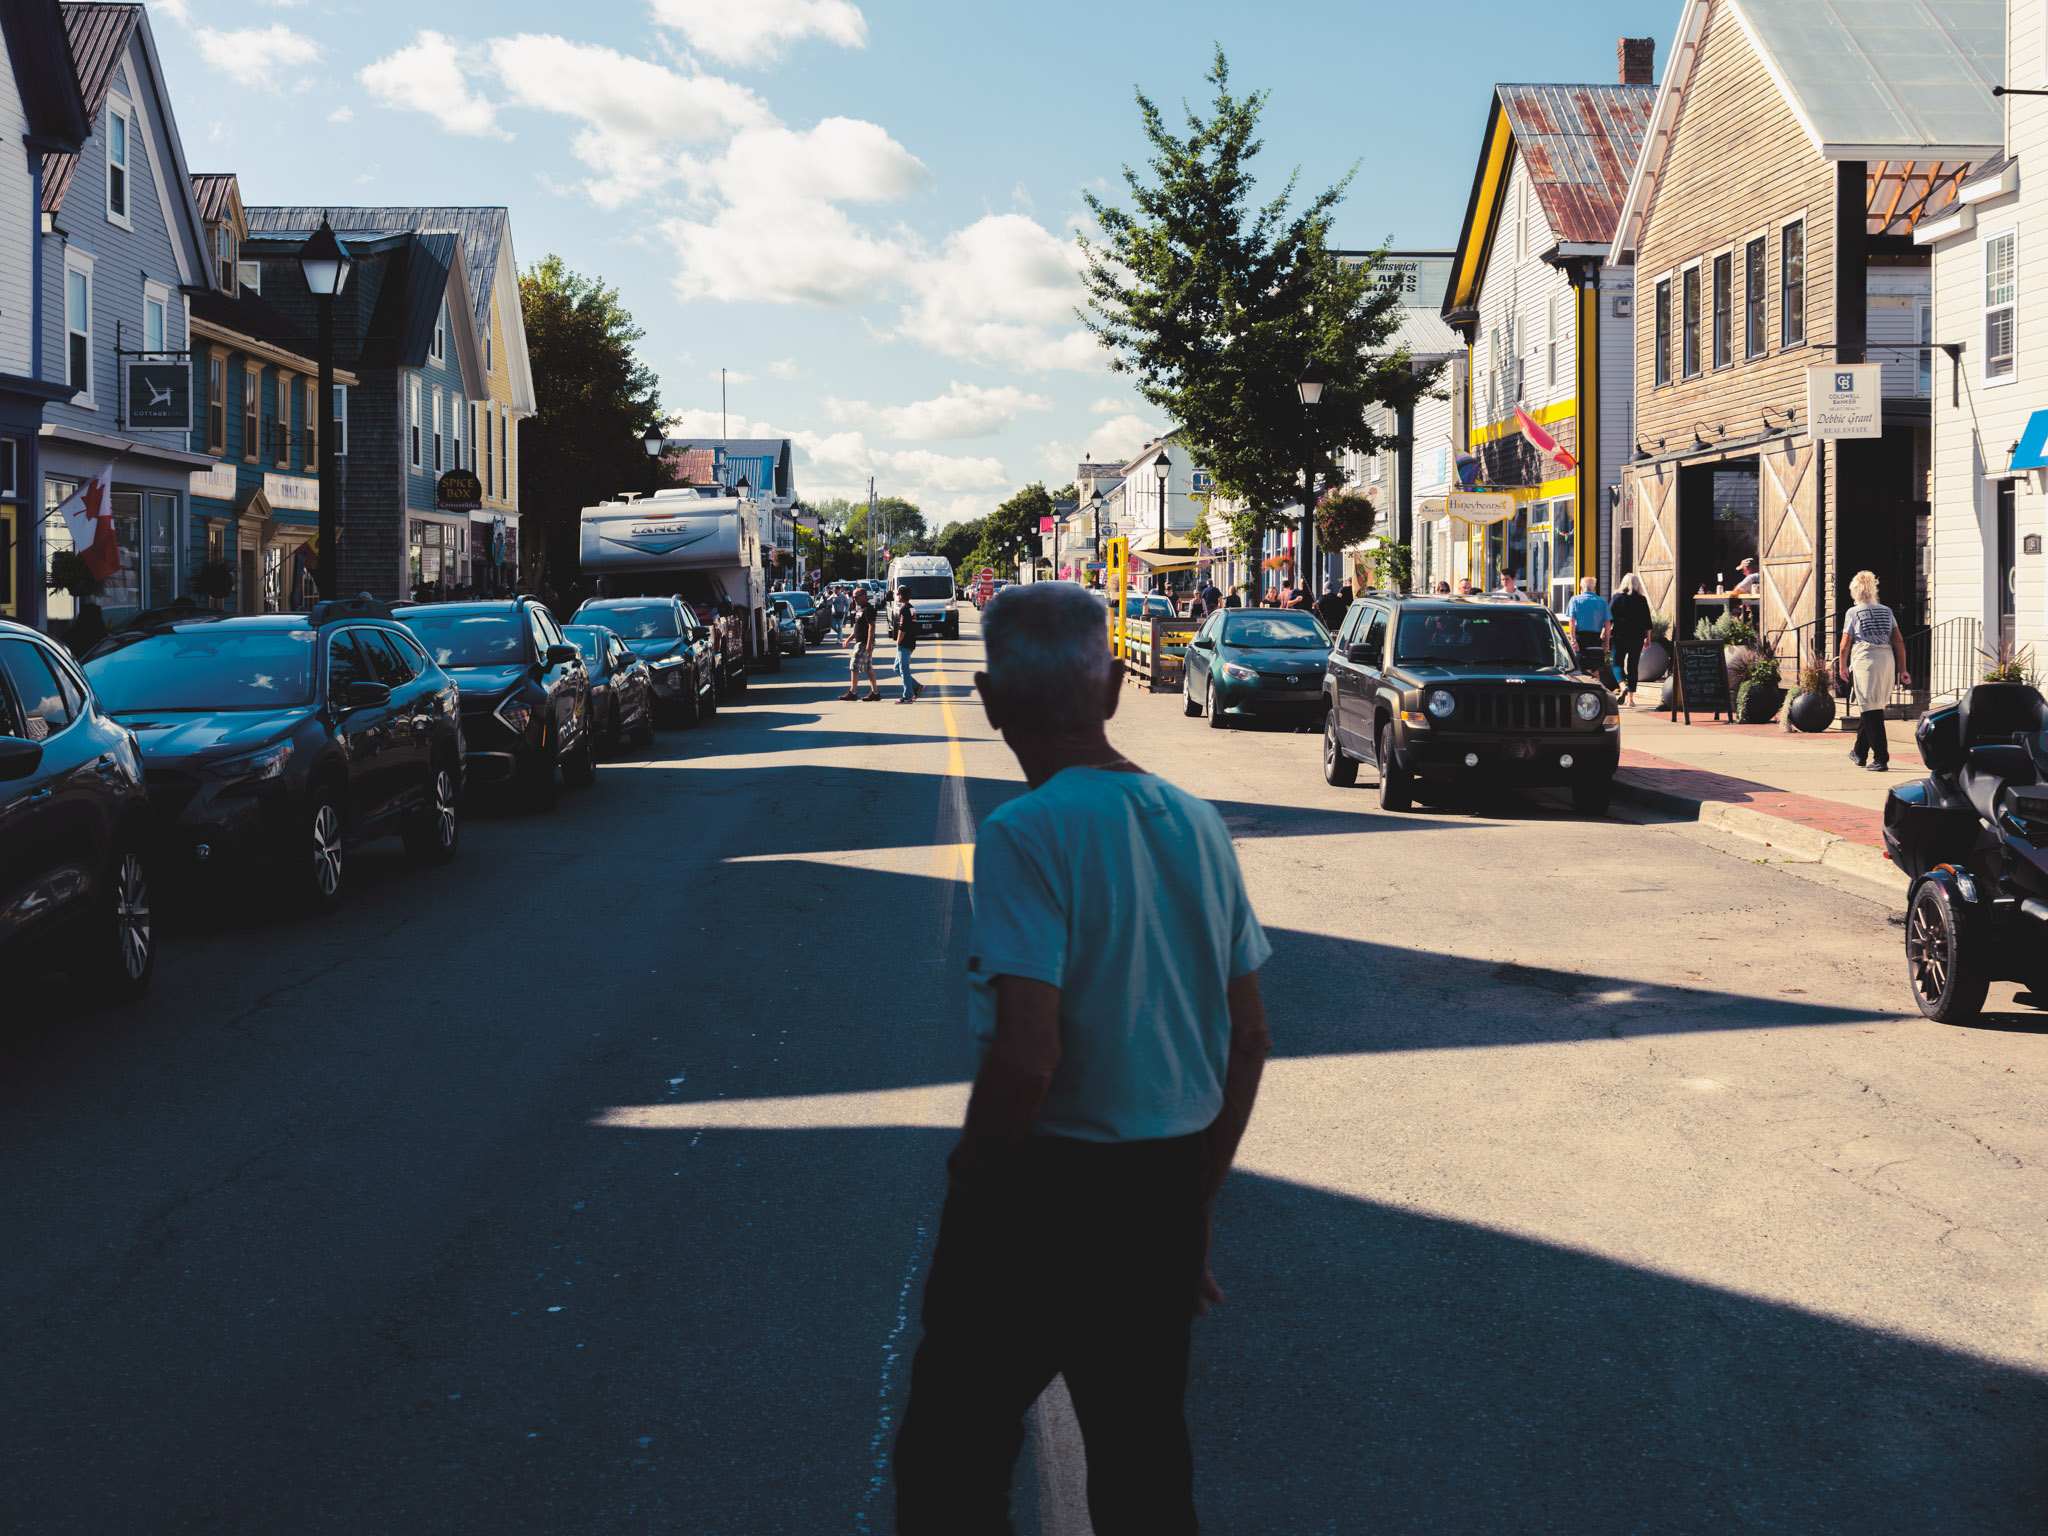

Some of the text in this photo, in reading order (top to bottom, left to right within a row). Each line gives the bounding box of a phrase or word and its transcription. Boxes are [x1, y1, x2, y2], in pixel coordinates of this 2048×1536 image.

[1816, 412, 1873, 425] Debbie Grant
[442, 478, 475, 488] SPICE
[446, 488, 471, 498] BOX
[631, 524, 687, 534] LANCE
